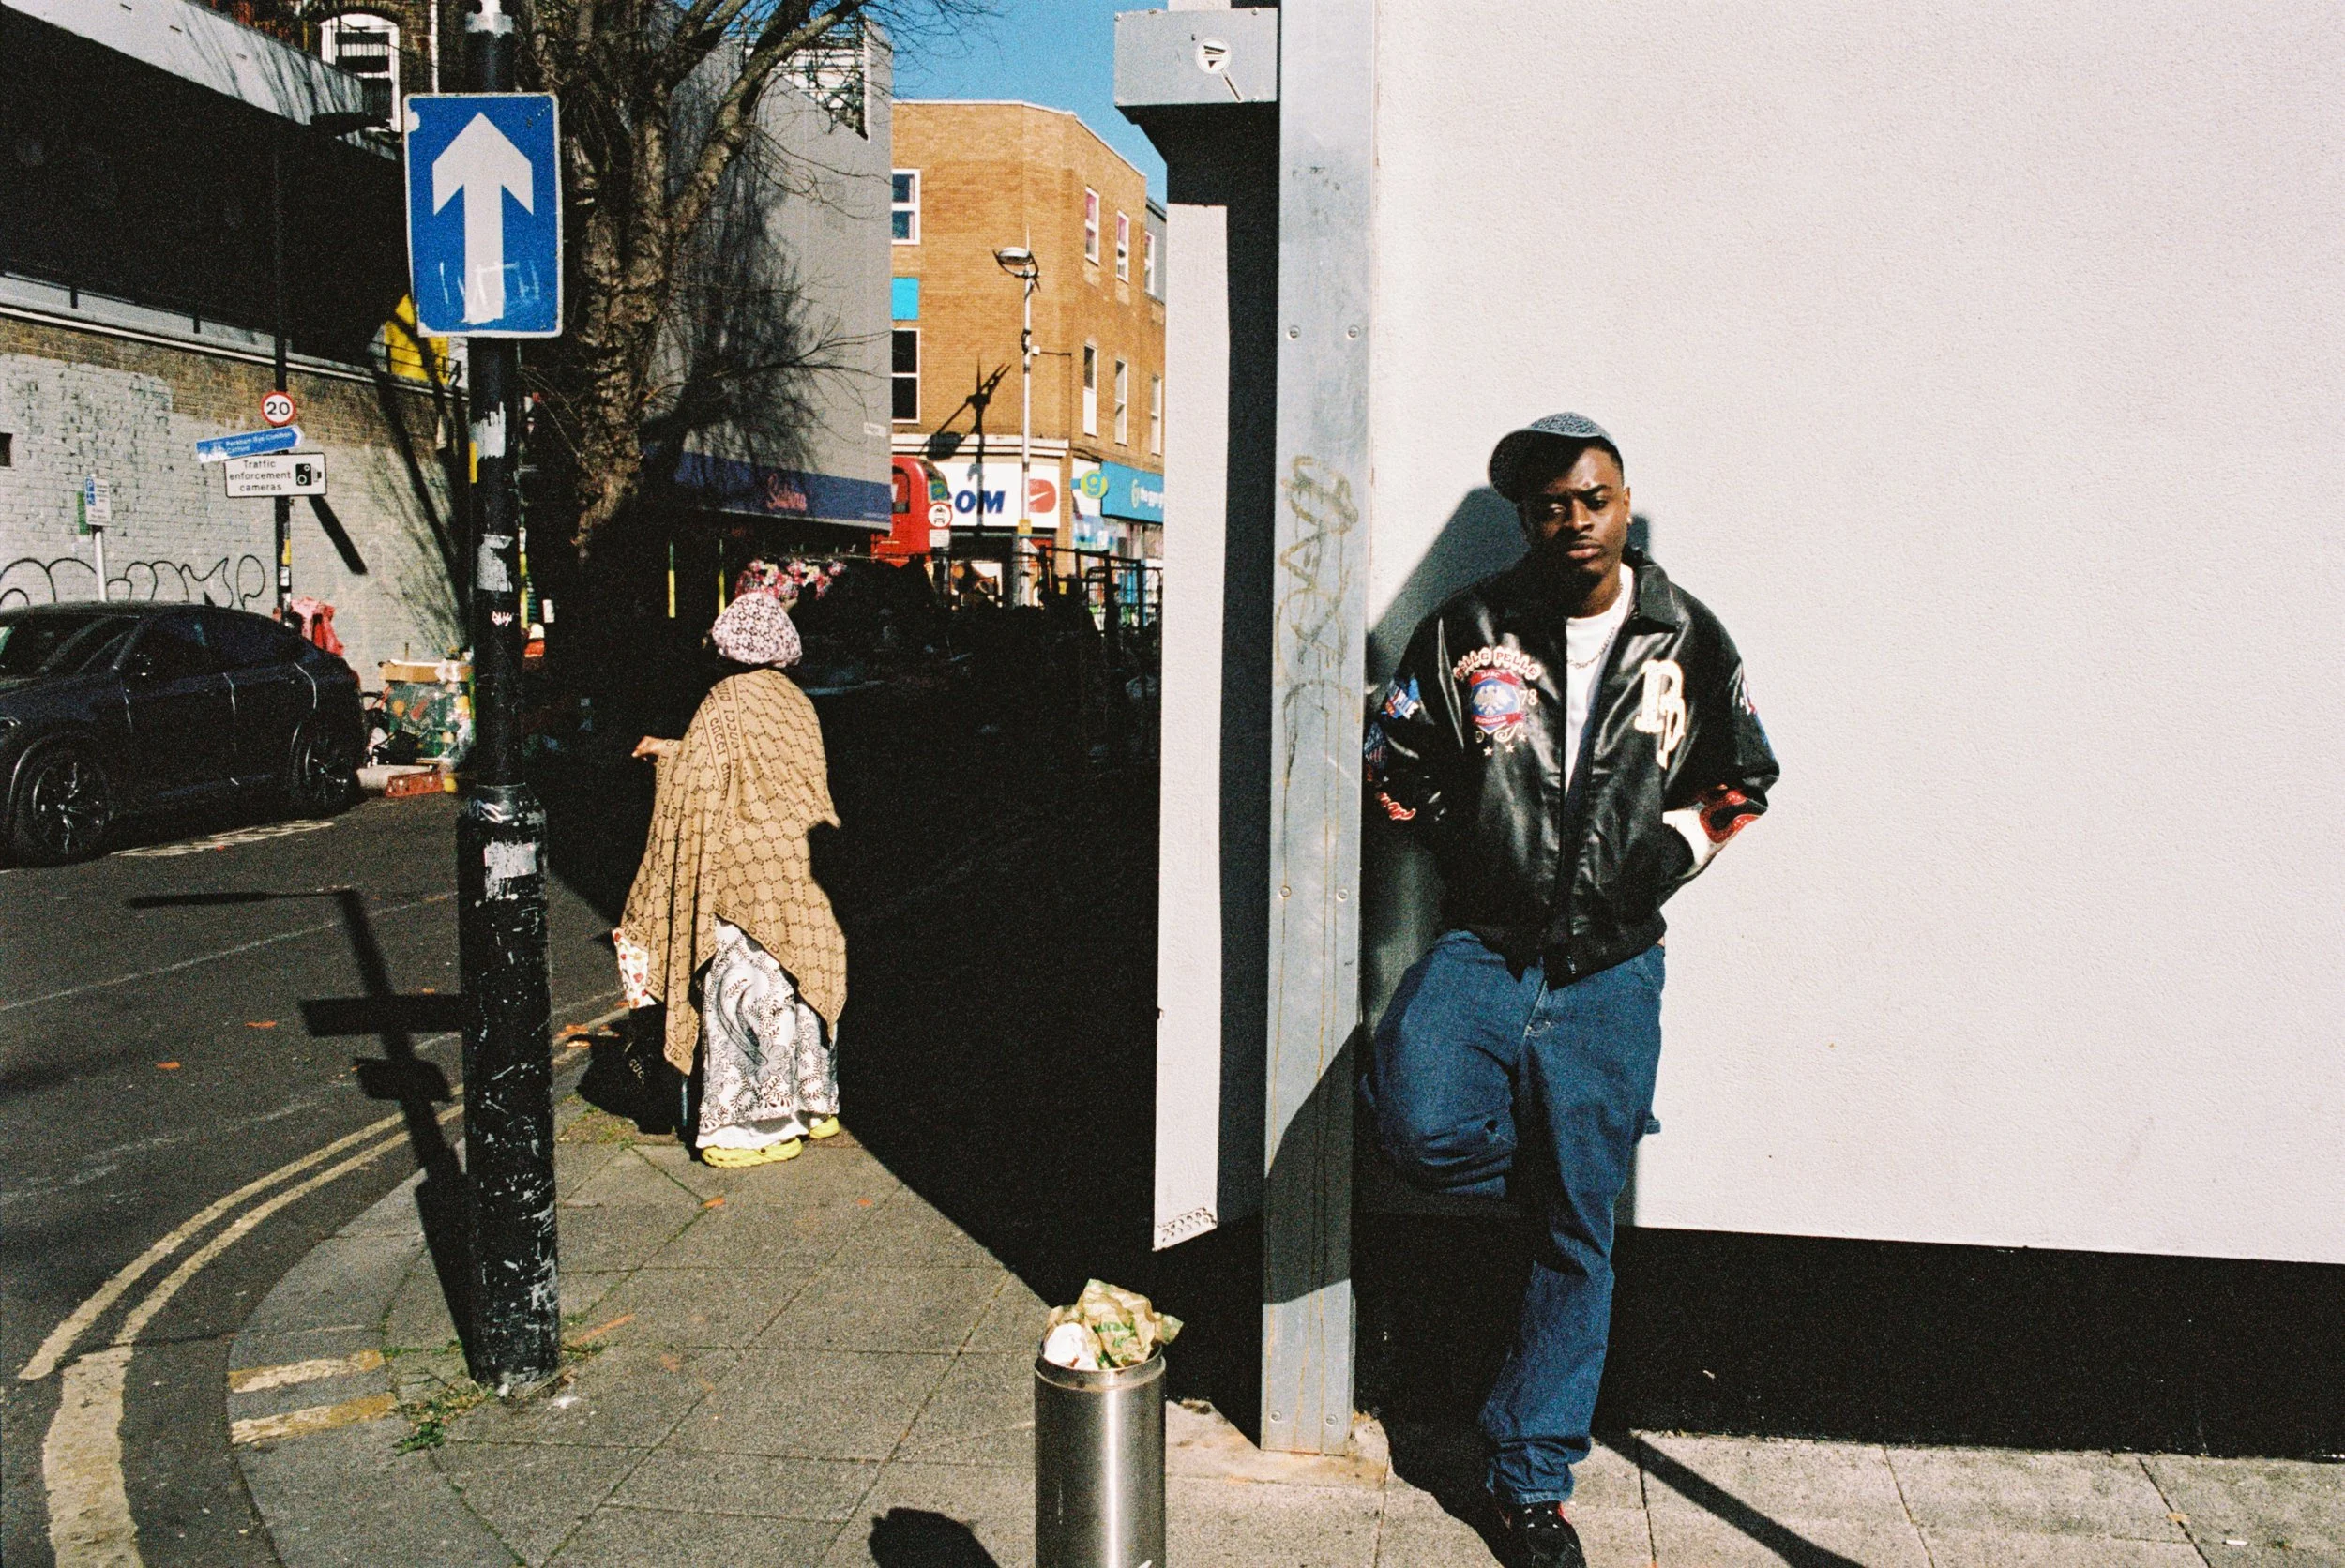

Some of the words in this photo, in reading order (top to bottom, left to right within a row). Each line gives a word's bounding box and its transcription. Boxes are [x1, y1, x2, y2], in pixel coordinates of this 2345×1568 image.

[266, 401, 291, 415] 20
[243, 460, 277, 469] Traffic
[229, 471, 292, 481] enforcement
[239, 483, 282, 492] cameras
[947, 490, 1006, 514] OM
[1493, 646, 1541, 680] PELLE
[1481, 670, 1501, 679] MARC
[1519, 688, 1538, 706] 78
